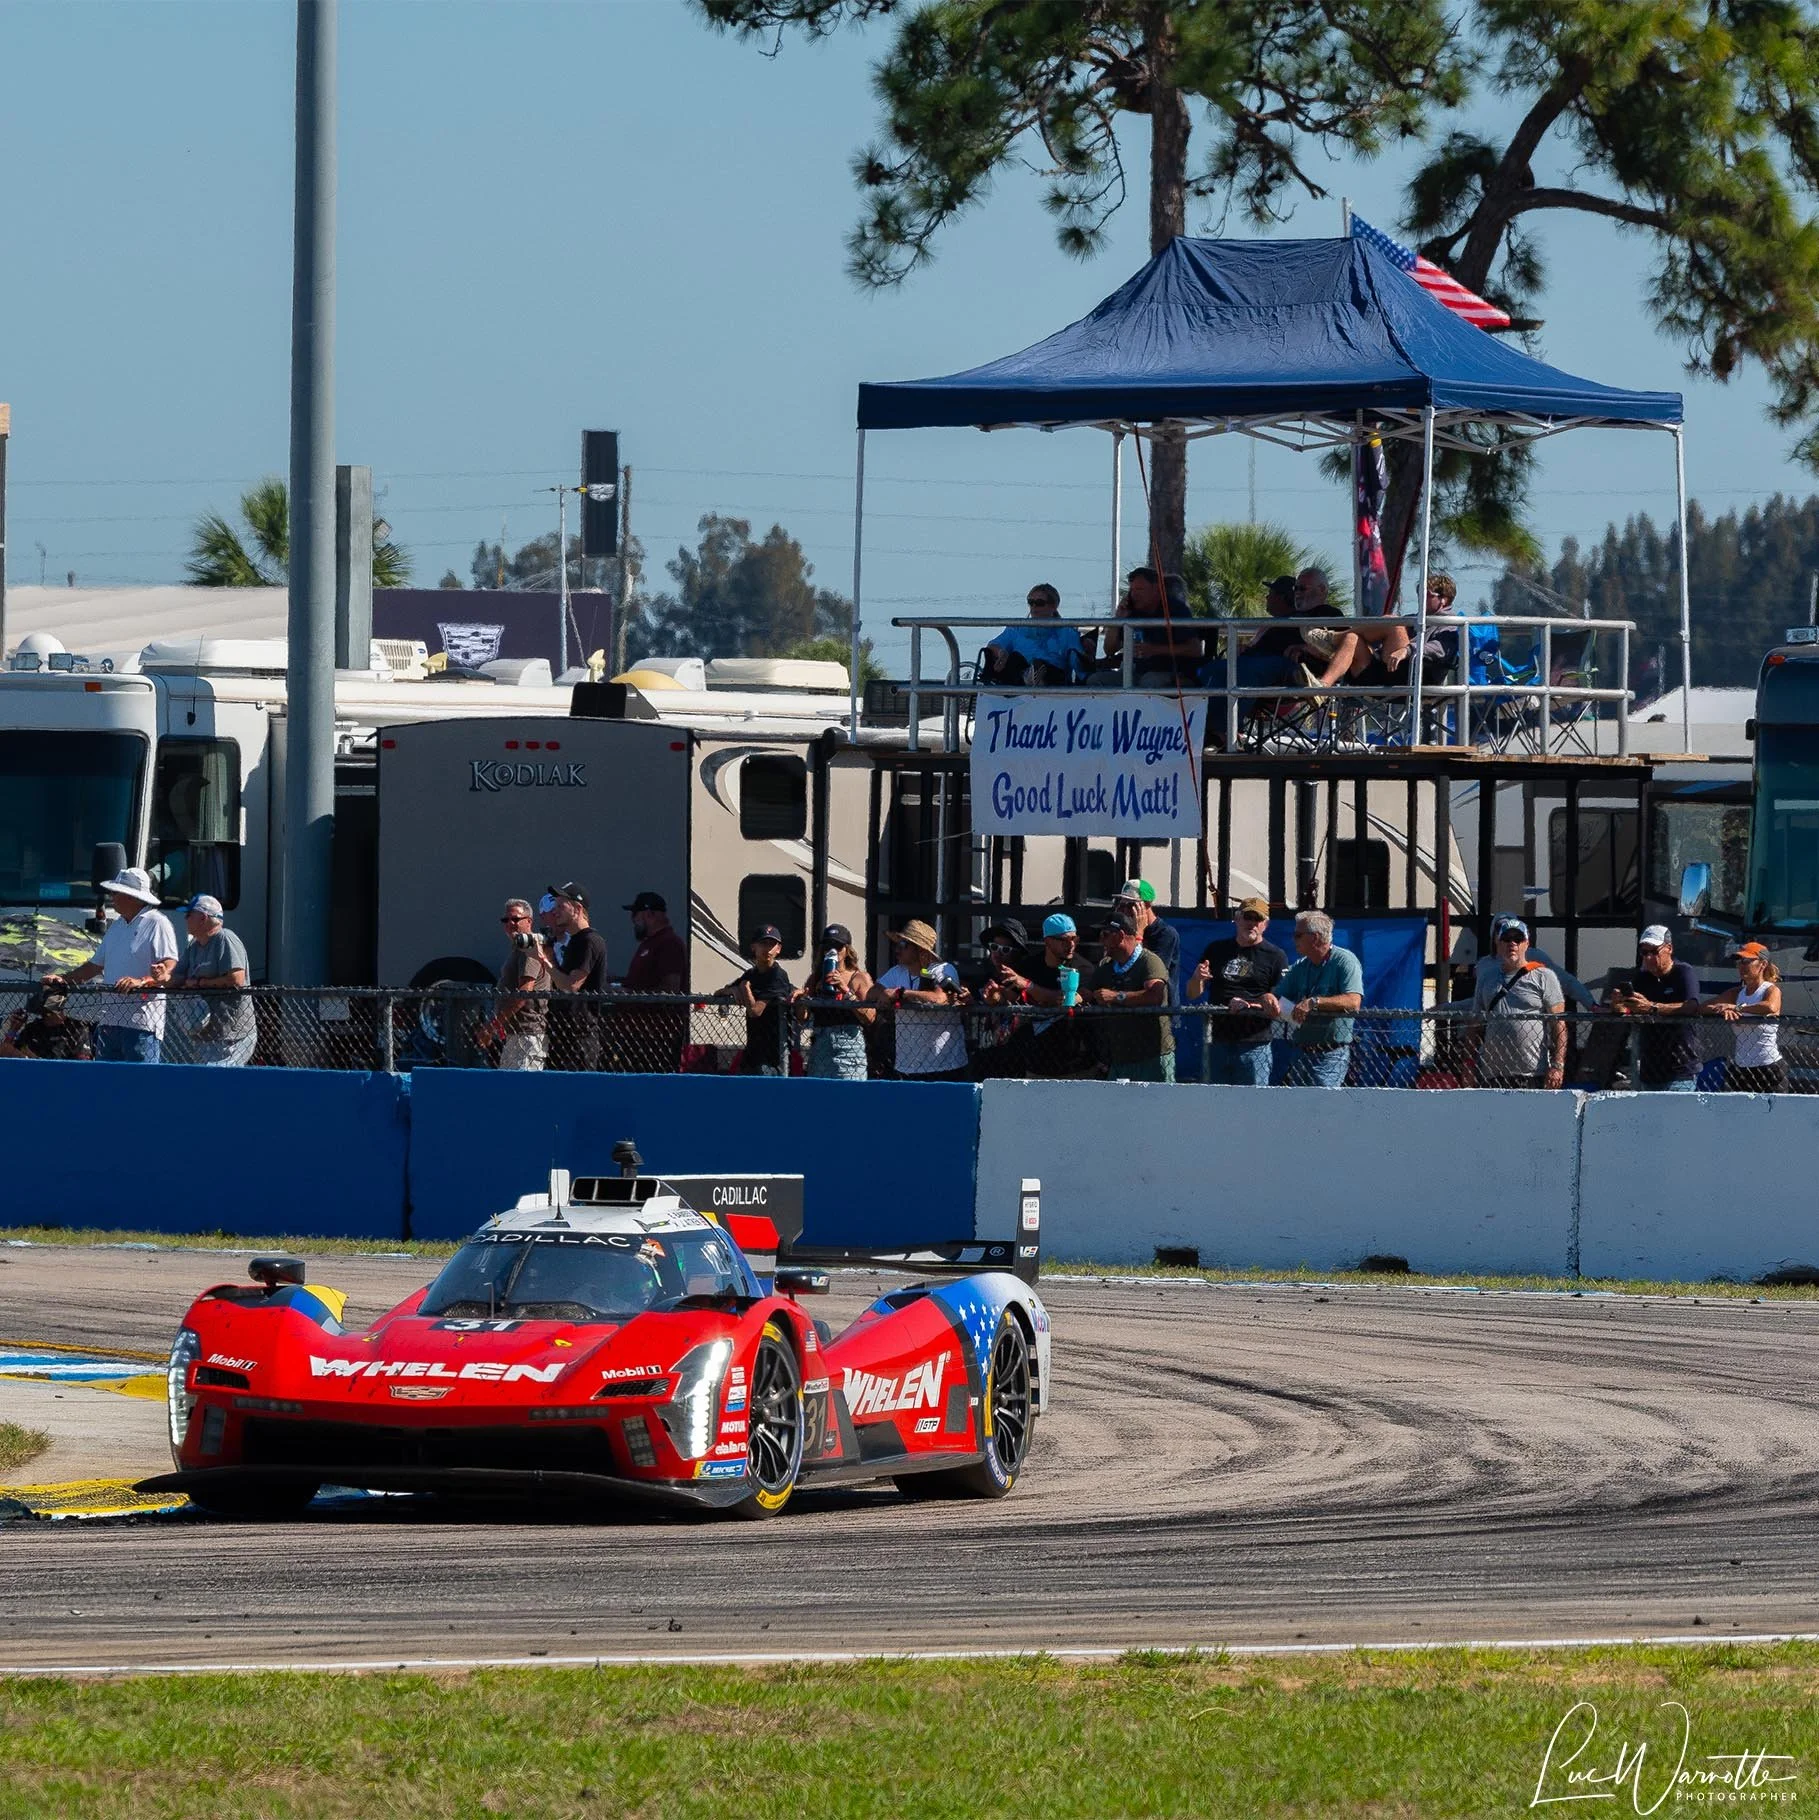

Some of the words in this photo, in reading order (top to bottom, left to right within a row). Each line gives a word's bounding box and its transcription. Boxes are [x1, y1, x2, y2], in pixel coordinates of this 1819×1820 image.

[987, 707, 1058, 753] Thank
[1066, 707, 1102, 753] You
[992, 771, 1052, 820] Good
[1056, 771, 1107, 819] Luck
[1111, 771, 1179, 822] Matt!
[712, 1185, 768, 1206] CADILLAC
[470, 1233, 631, 1248] CADILLAC
[443, 1319, 515, 1331] 31
[206, 1352, 244, 1368] Mobil
[309, 1355, 567, 1383] WHELEN
[601, 1366, 646, 1379] Mobil
[841, 1351, 947, 1416] WHELEN
[721, 1420, 746, 1433] MOTUL
[803, 1396, 827, 1451] 31
